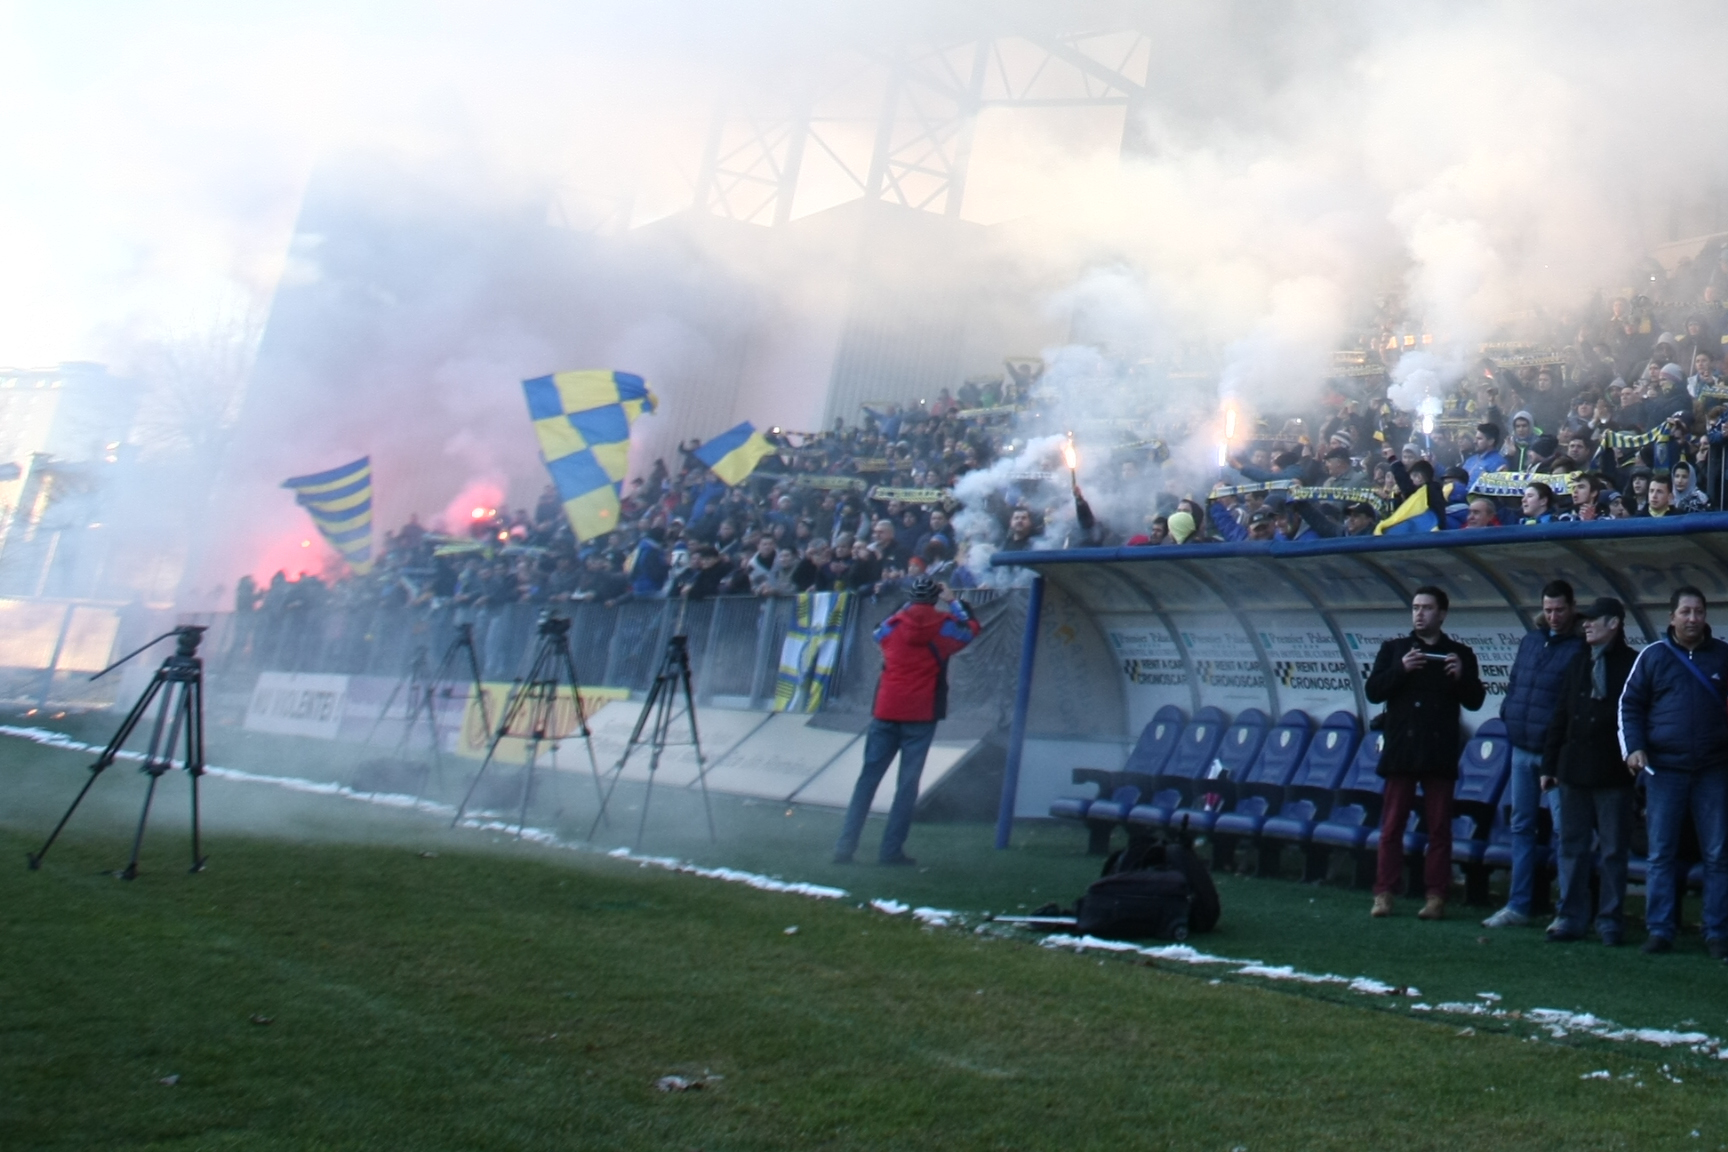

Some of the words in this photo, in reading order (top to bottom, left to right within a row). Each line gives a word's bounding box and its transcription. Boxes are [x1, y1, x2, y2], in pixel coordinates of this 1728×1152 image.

[1451, 633, 1493, 646] Premier
[1497, 633, 1522, 647] Pala
[1295, 661, 1320, 673] RENT
[1482, 665, 1509, 678] RENT
[1290, 676, 1354, 691] CRONOSCAR
